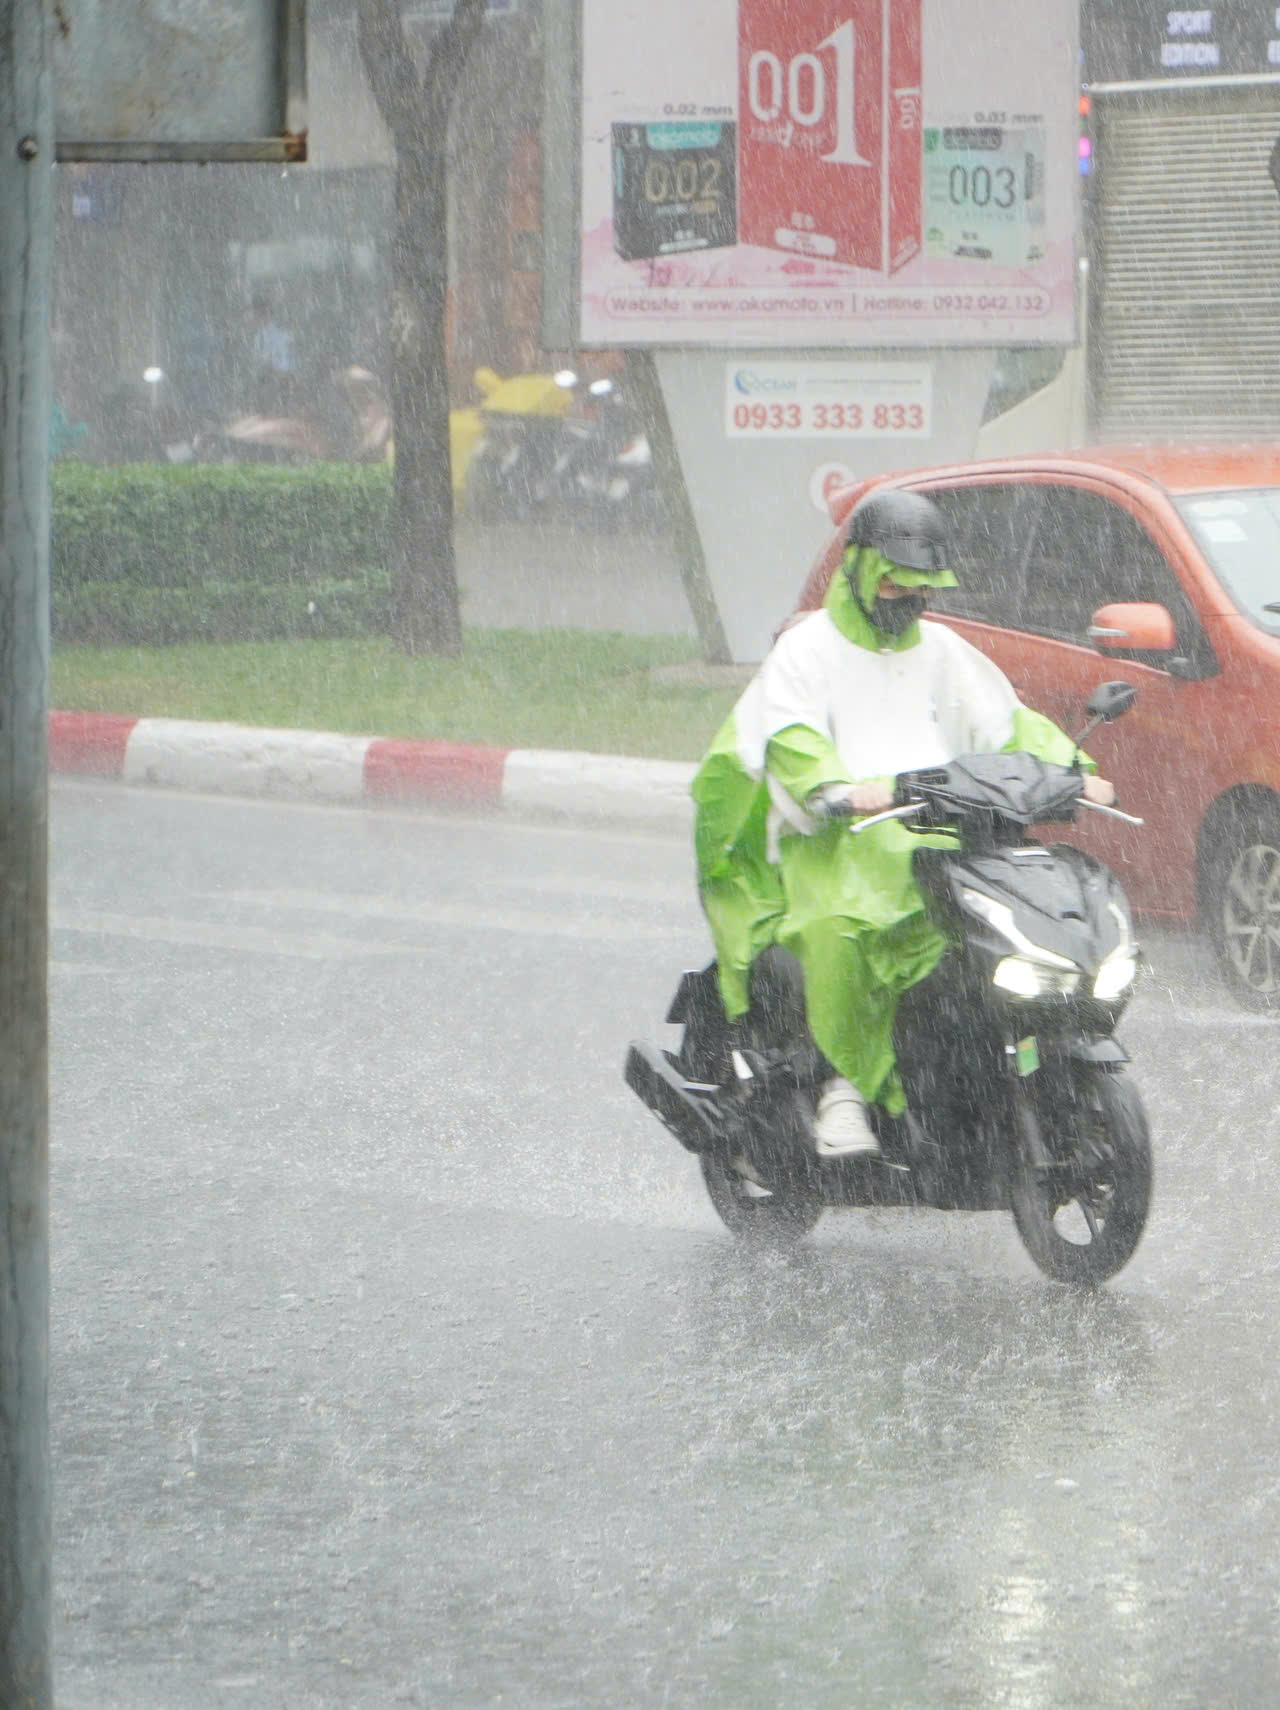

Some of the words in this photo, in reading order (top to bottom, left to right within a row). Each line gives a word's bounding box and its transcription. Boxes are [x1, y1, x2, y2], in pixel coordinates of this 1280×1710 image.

[1167, 10, 1212, 35] SPORT
[1161, 43, 1220, 66] EDITION
[734, 403, 802, 430] 0933
[813, 403, 863, 430] 333
[873, 403, 924, 430] 833
